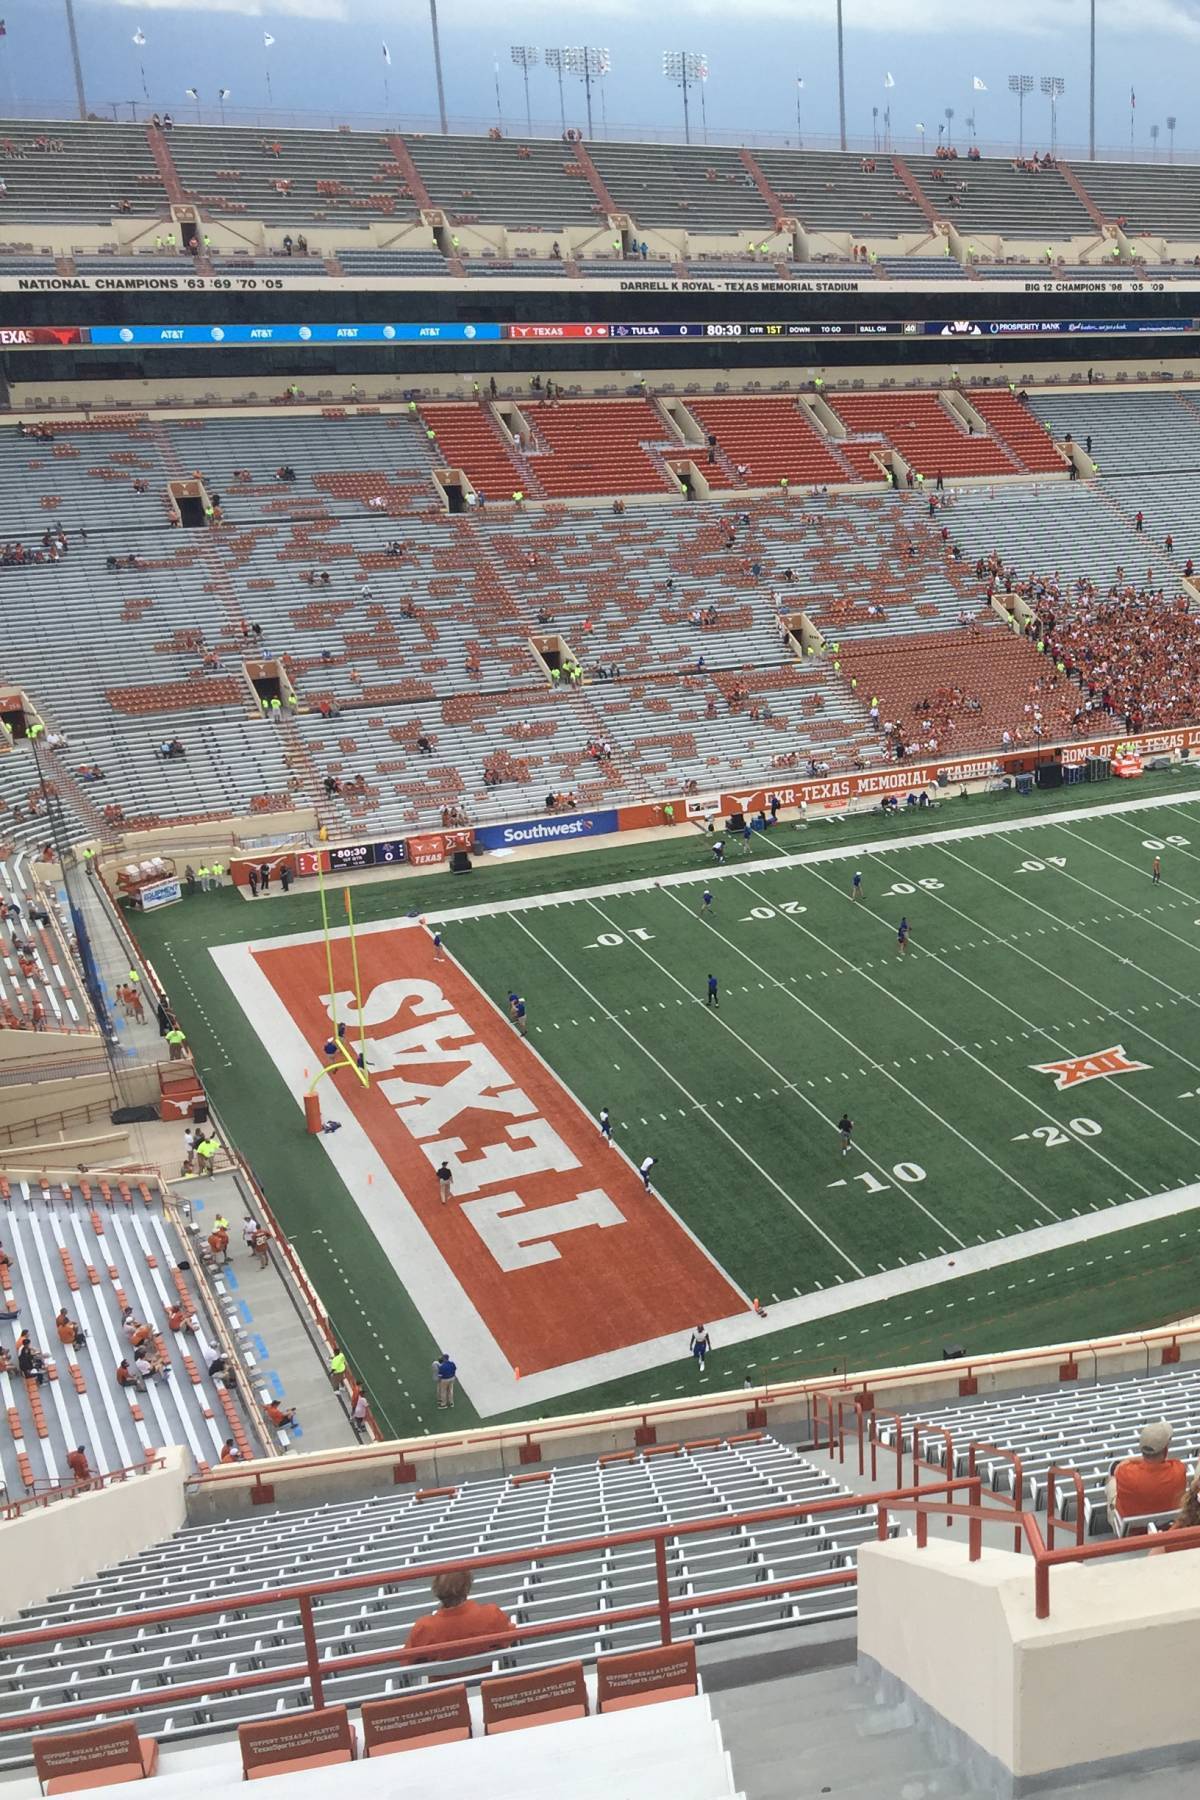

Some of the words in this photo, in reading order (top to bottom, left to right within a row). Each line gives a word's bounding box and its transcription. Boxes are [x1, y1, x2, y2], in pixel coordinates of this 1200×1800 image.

[19, 279, 90, 290] NATIONAL
[95, 279, 178, 289] CHAMPIONS
[183, 279, 205, 289] '63
[210, 279, 231, 289] '69
[236, 279, 257, 289] '70
[261, 279, 283, 289] '05
[620, 281, 669, 291] DARRELL
[671, 281, 679, 291] K
[682, 281, 715, 291] ROYAL
[725, 282, 759, 292] TEXAS
[762, 282, 814, 292] MEMORIAL
[816, 282, 858, 292] STADIUM
[1025, 283, 1040, 292] BIG
[1043, 283, 1053, 292] 12
[1055, 283, 1106, 292] CHAMPIONS
[1130, 283, 1144, 292] '05
[1150, 283, 1165, 292] '09
[532, 327, 564, 336] TEXAS
[584, 326, 592, 335] 0
[631, 326, 660, 335] TULSA
[680, 326, 687, 335] 0
[707, 325, 742, 336] 80:30
[766, 325, 782, 335] 1ST
[789, 326, 810, 334] DOWN
[1000, 322, 1039, 331] PROSPERITY
[1041, 322, 1060, 331] BANK
[161, 330, 184, 339] AT&T
[251, 329, 273, 338] AT&T
[337, 328, 358, 337] AT&T
[420, 328, 440, 337] AT&T
[1144, 733, 1184, 752] TEXAS
[765, 781, 850, 806] DKR-TEXAS
[858, 769, 930, 793] MEMORIAL
[504, 819, 584, 843] Southwest
[1141, 835, 1191, 850] 50
[415, 853, 442, 864] TEXAS
[1022, 856, 1068, 872] 40
[891, 877, 945, 896] 30
[750, 901, 807, 921] 20
[597, 927, 656, 948] 10
[318, 977, 628, 1273] TEXAS
[1032, 1117, 1103, 1148] 20
[853, 1161, 927, 1194] 10
